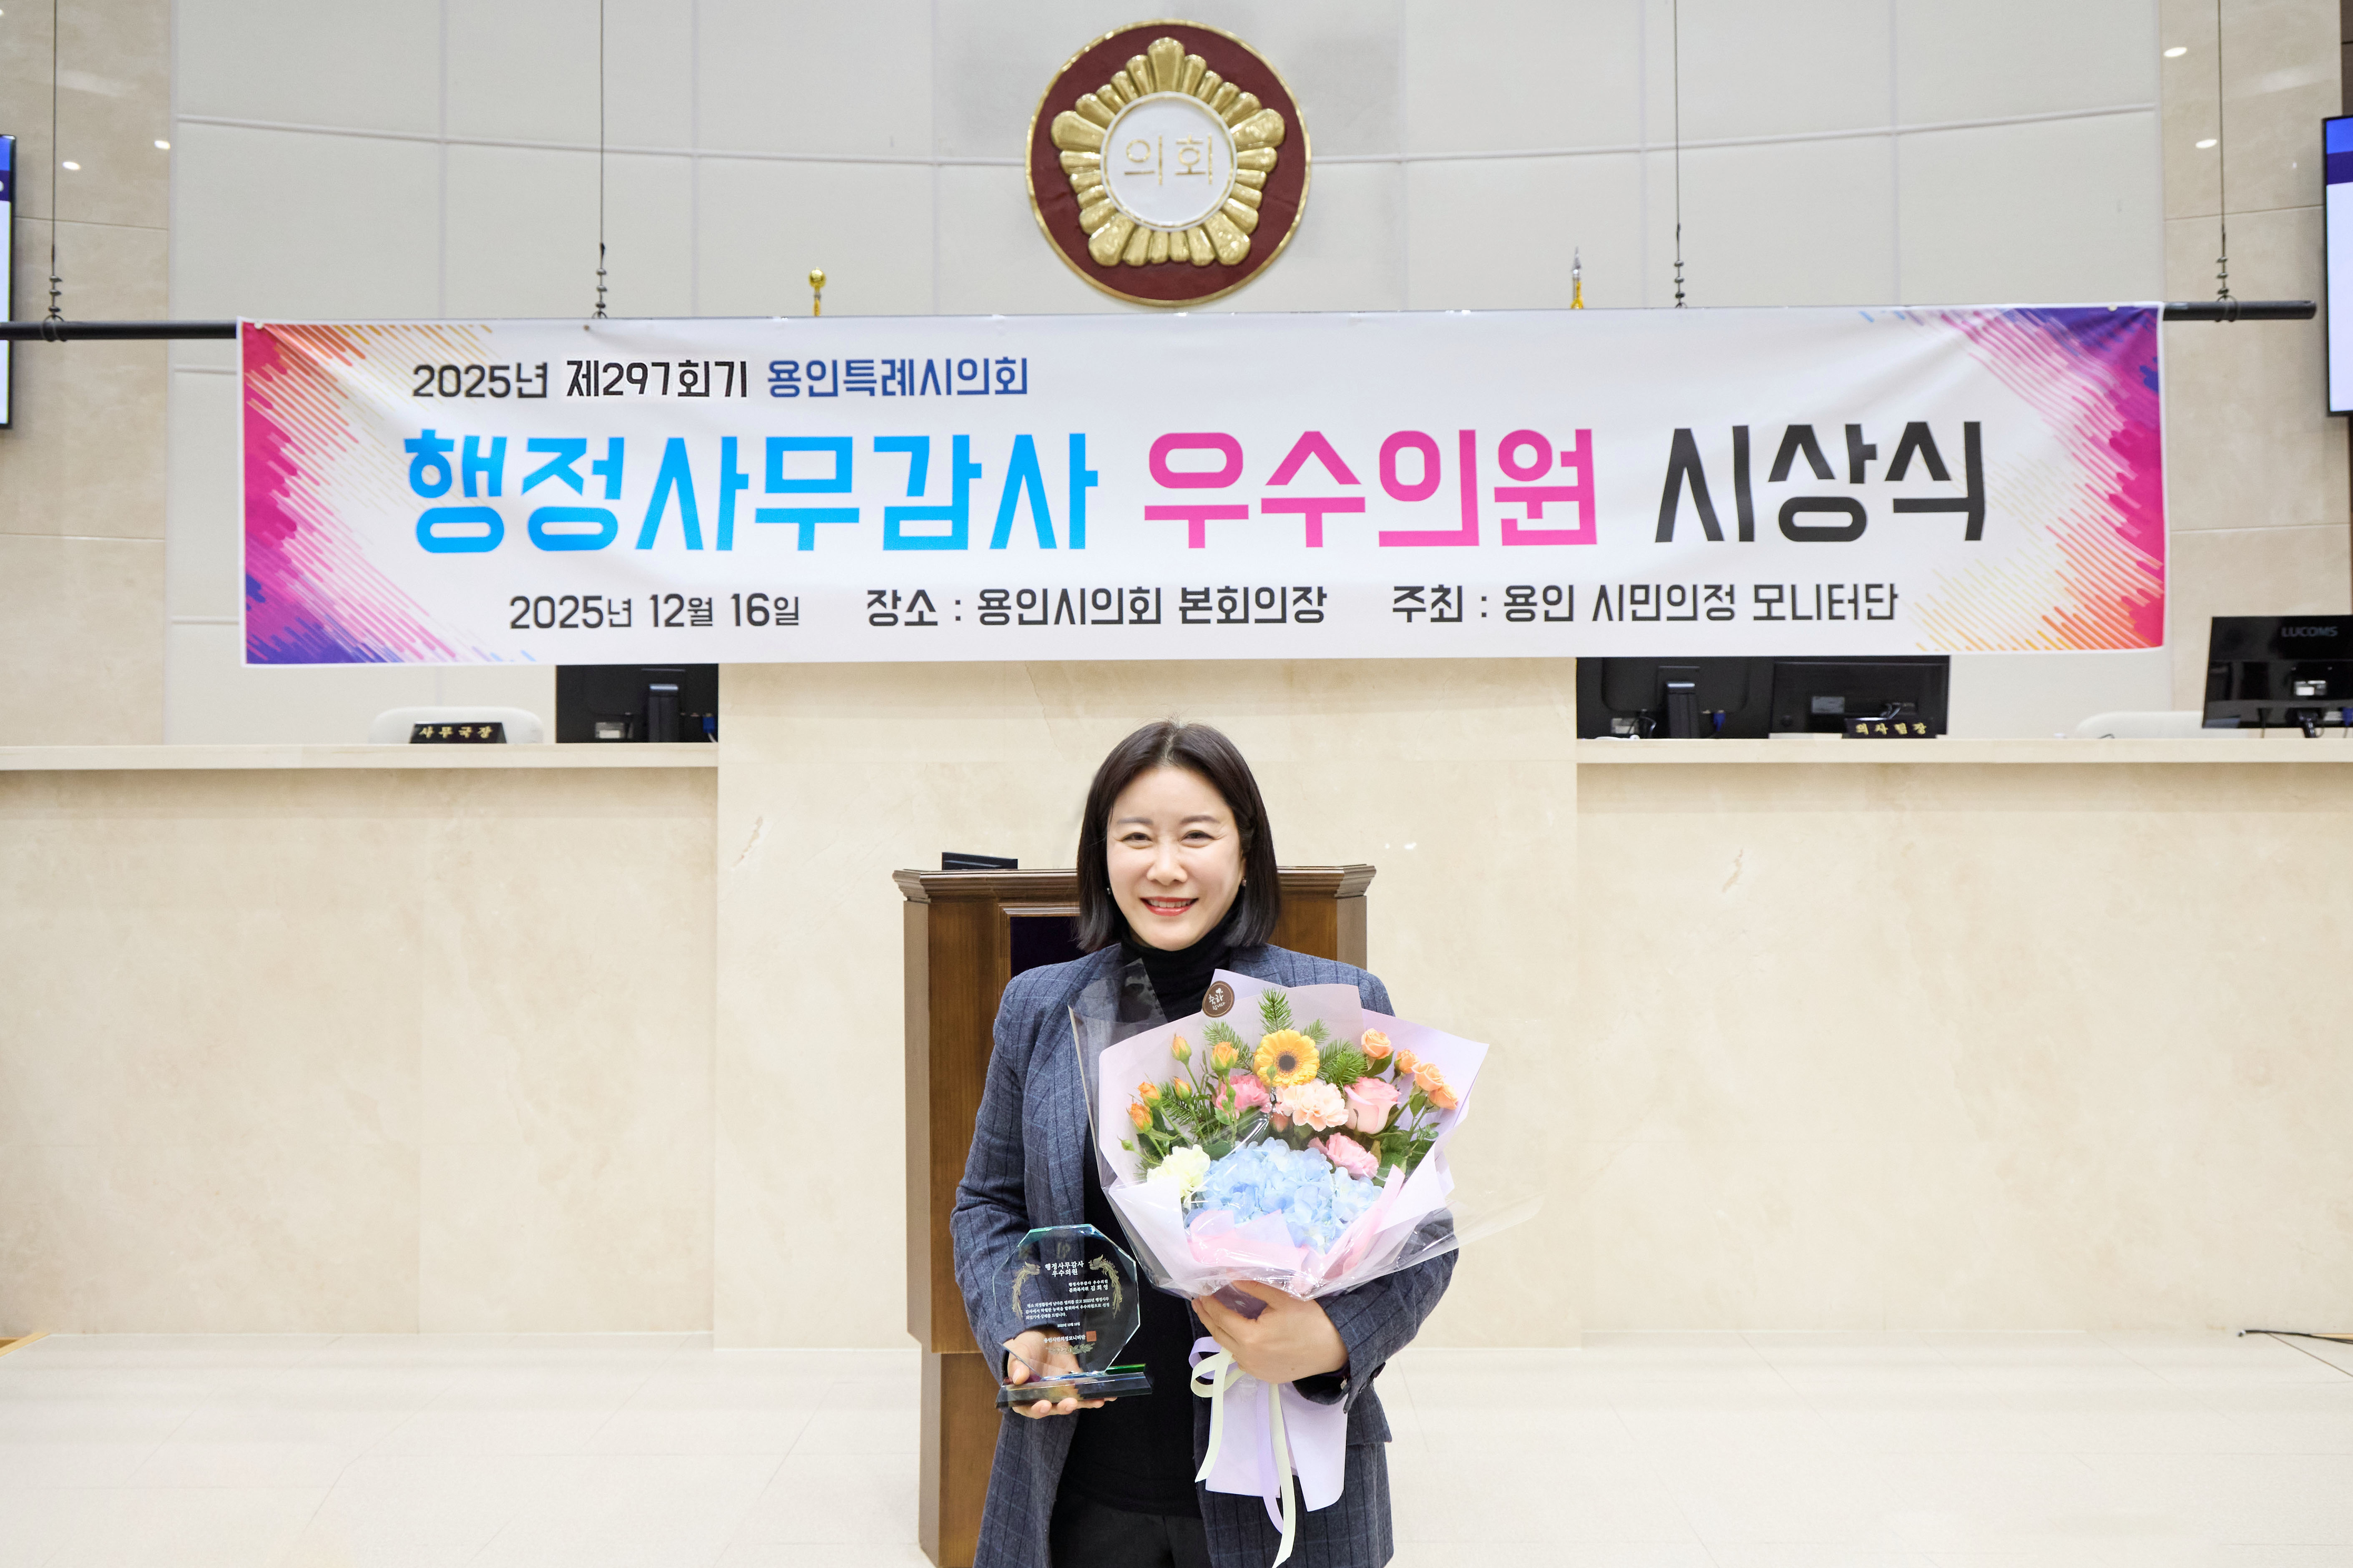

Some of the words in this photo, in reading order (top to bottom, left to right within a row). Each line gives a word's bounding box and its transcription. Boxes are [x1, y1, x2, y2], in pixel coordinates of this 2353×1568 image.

[1124, 132, 1213, 186] 의회
[412, 362, 548, 399] 2025년
[567, 359, 747, 397] 제297회기
[767, 357, 1028, 398] 용인특례시의회
[403, 428, 1099, 553] 행정사무감사
[1144, 429, 1597, 548] 우수의원
[1654, 421, 1986, 543] 시상식
[510, 595, 632, 629] 2025년
[650, 593, 713, 627] 12월
[731, 593, 799, 626] 16일
[867, 589, 938, 626] 장소
[978, 586, 1161, 626] 용인시의회
[1179, 585, 1327, 624] 본회의장
[1393, 584, 1463, 623] 주최
[1504, 585, 1574, 622] 용인
[1592, 584, 1735, 621] 시민의정
[1753, 583, 1898, 621] 모니터단
[2281, 626, 2338, 637] LUCOMS
[1045, 1260, 1084, 1271] 행정사무감사
[1052, 1268, 1078, 1277] 우수의원
[1043, 1334, 1086, 1343] 용인시민의정모니터단
